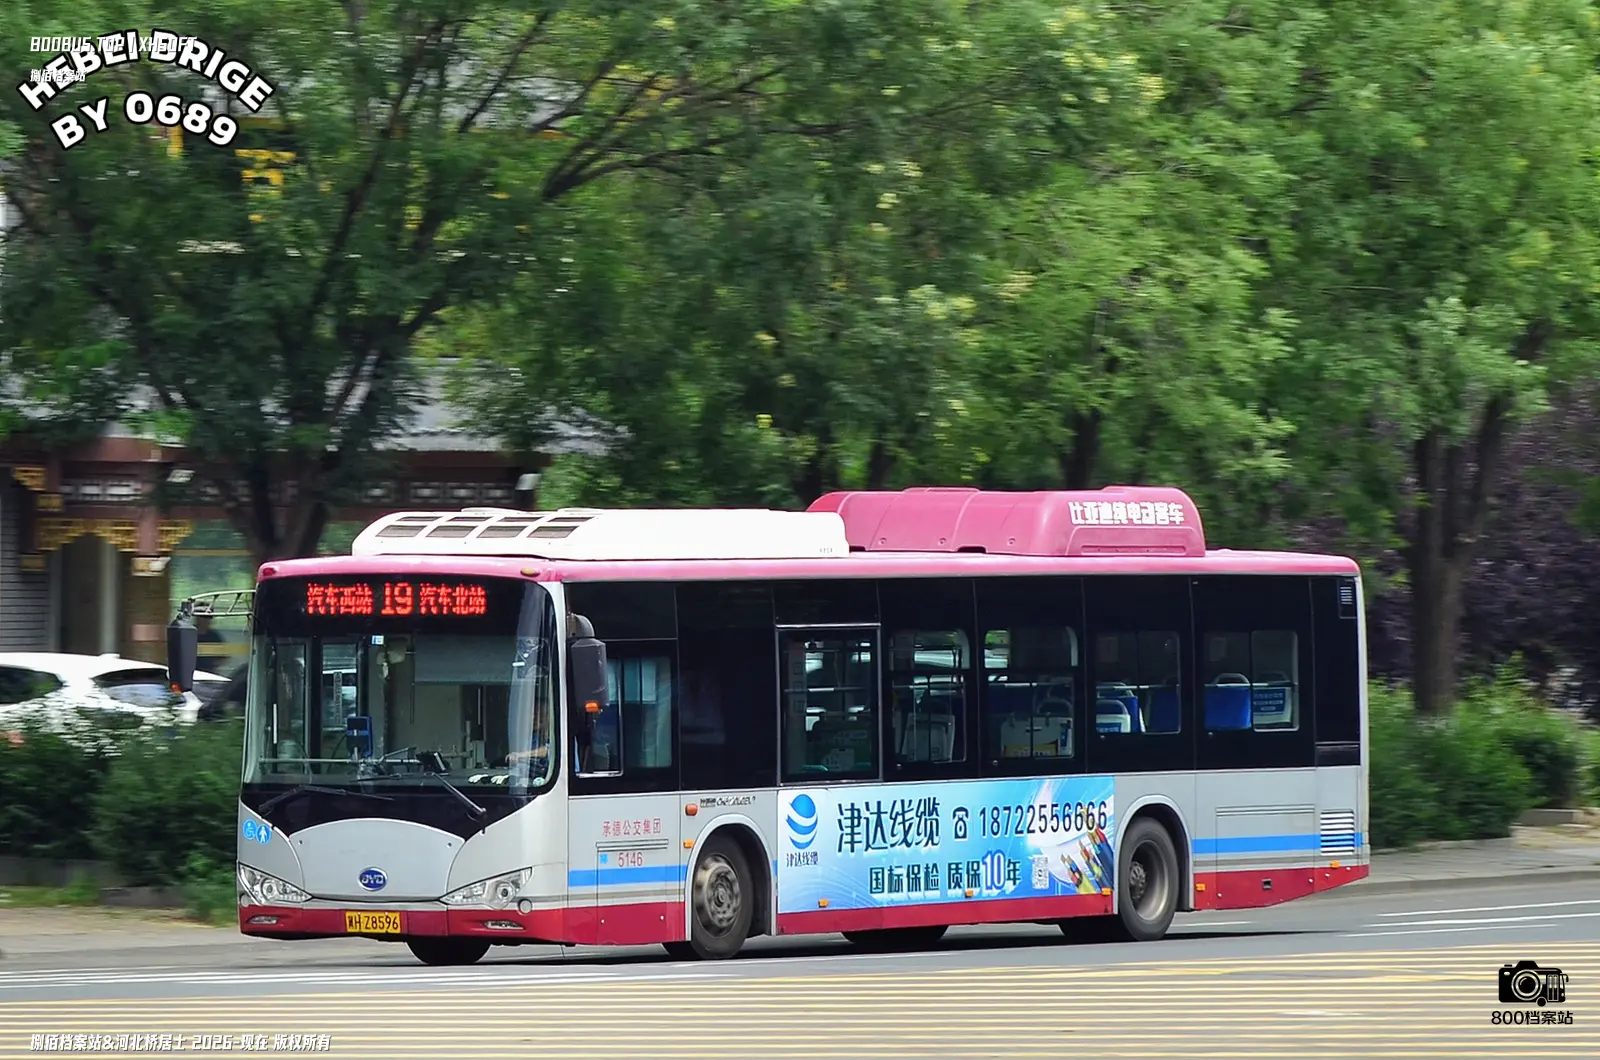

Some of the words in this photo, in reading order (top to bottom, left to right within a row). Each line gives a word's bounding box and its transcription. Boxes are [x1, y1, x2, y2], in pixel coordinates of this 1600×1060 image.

[307, 583, 373, 615] 汽车西站
[381, 583, 413, 615] 19
[419, 583, 487, 615] 汽车北站
[603, 818, 661, 837] 承德公交集团
[836, 797, 941, 854] 津达线缆
[979, 800, 1108, 838] 18722556666
[618, 851, 643, 868] 5146
[786, 852, 819, 868] 津达线缆
[869, 862, 940, 894] 国标保检
[947, 850, 1022, 890] 质保10年
[361, 874, 384, 884] BYD
